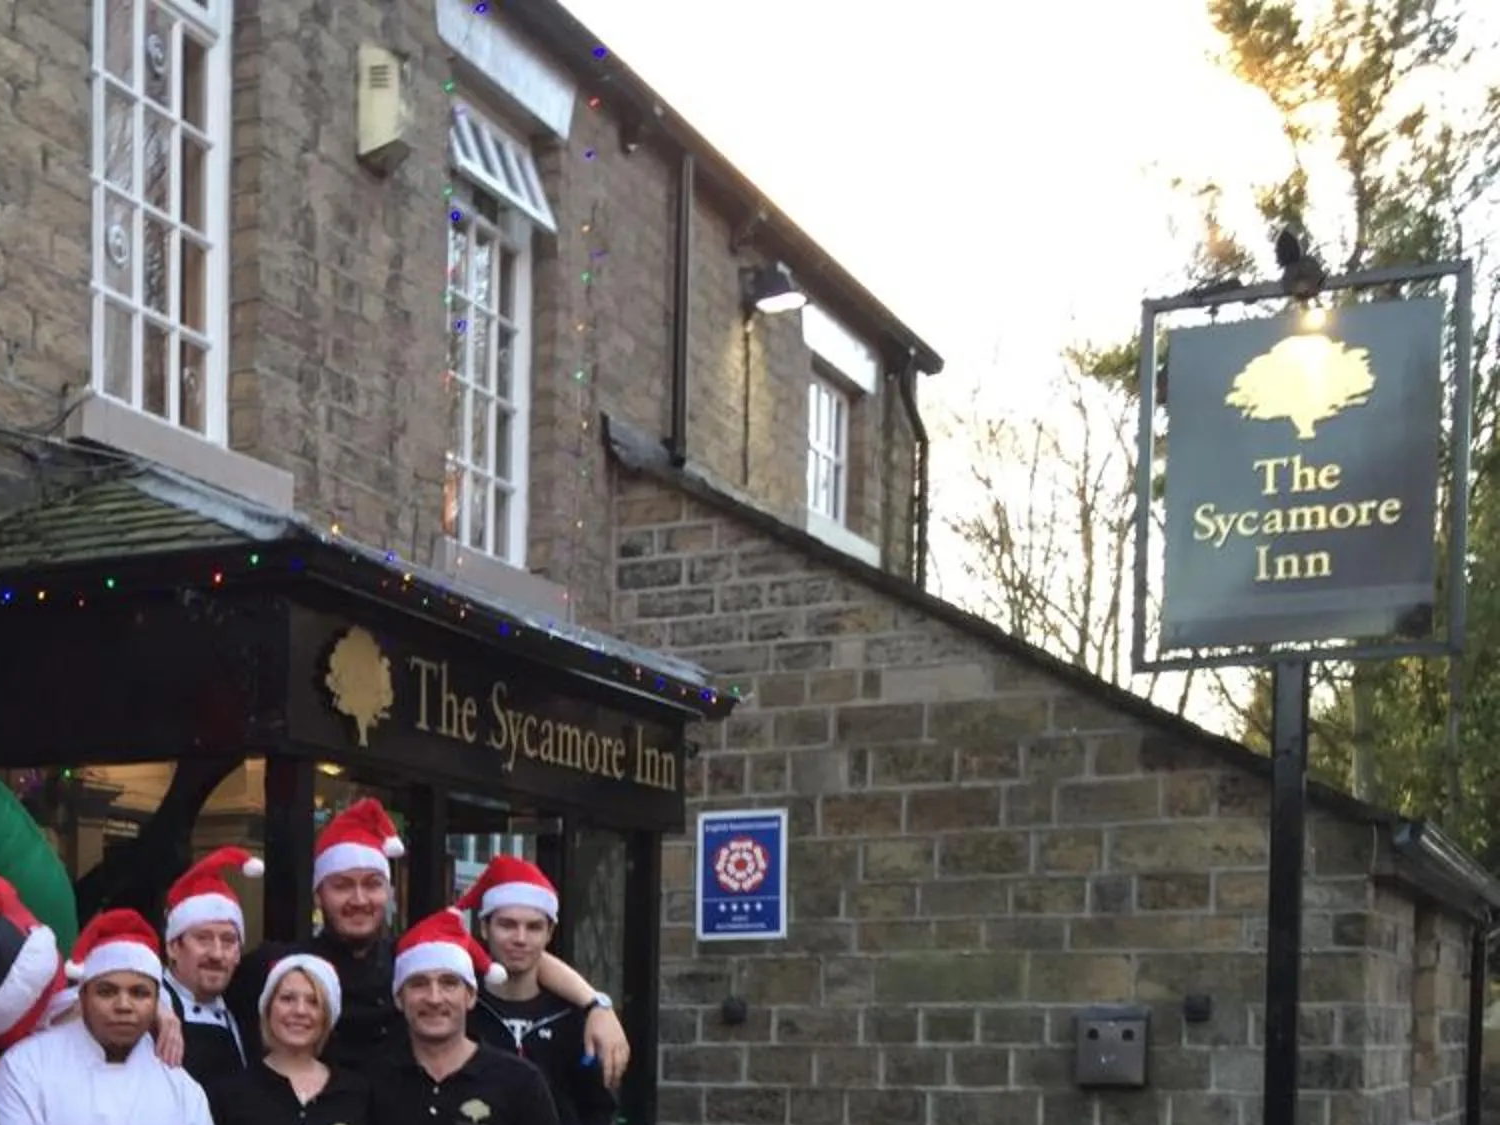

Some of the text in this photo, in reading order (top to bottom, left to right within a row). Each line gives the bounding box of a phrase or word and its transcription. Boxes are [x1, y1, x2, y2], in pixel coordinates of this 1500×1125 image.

[1253, 455, 1342, 496] The
[1193, 497, 1403, 548] Sycamore
[1254, 545, 1333, 582] Inn
[408, 656, 678, 791] The Sycamore Inn
